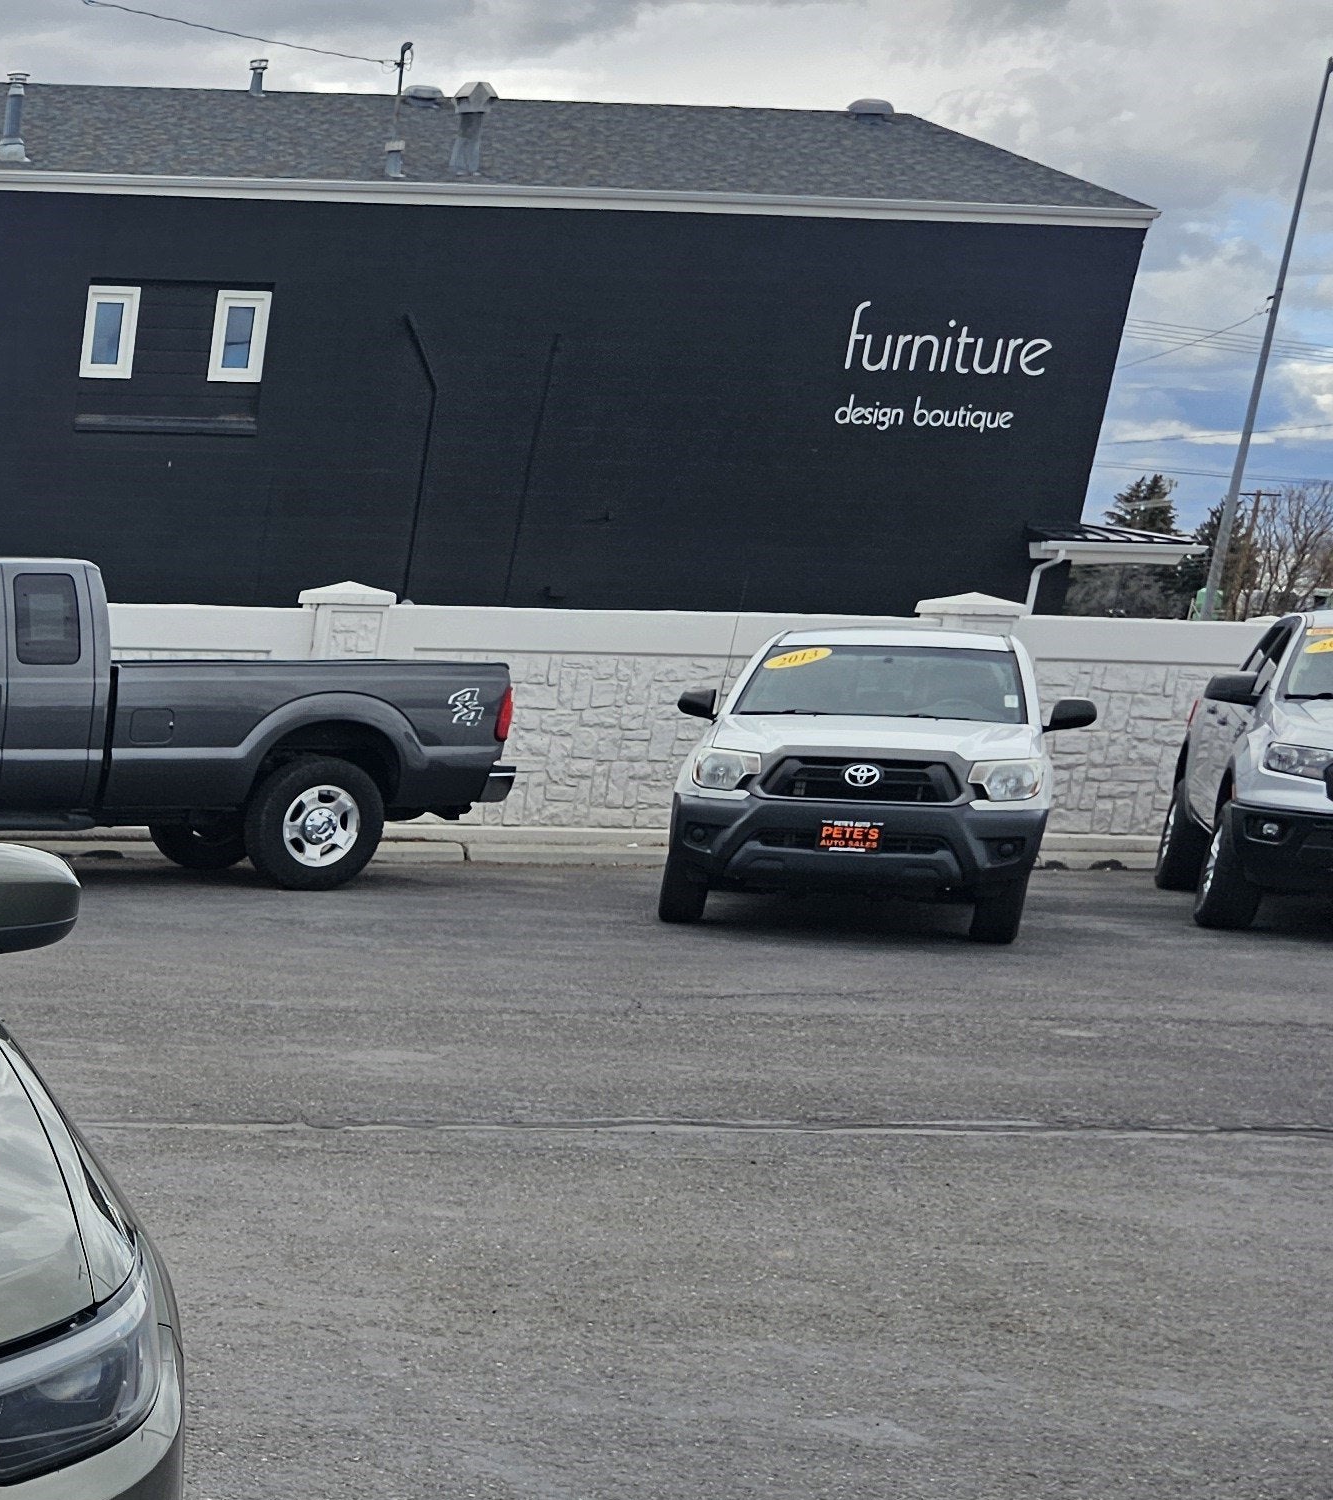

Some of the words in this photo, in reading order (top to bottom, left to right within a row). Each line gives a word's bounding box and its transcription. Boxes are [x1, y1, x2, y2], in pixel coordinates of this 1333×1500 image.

[844, 300, 1053, 376] furniture
[834, 394, 904, 431] design
[913, 396, 1014, 433] boutique
[819, 839, 846, 847] AUTO
[848, 840, 878, 849] SALES
[821, 826, 880, 840] PETE'S
